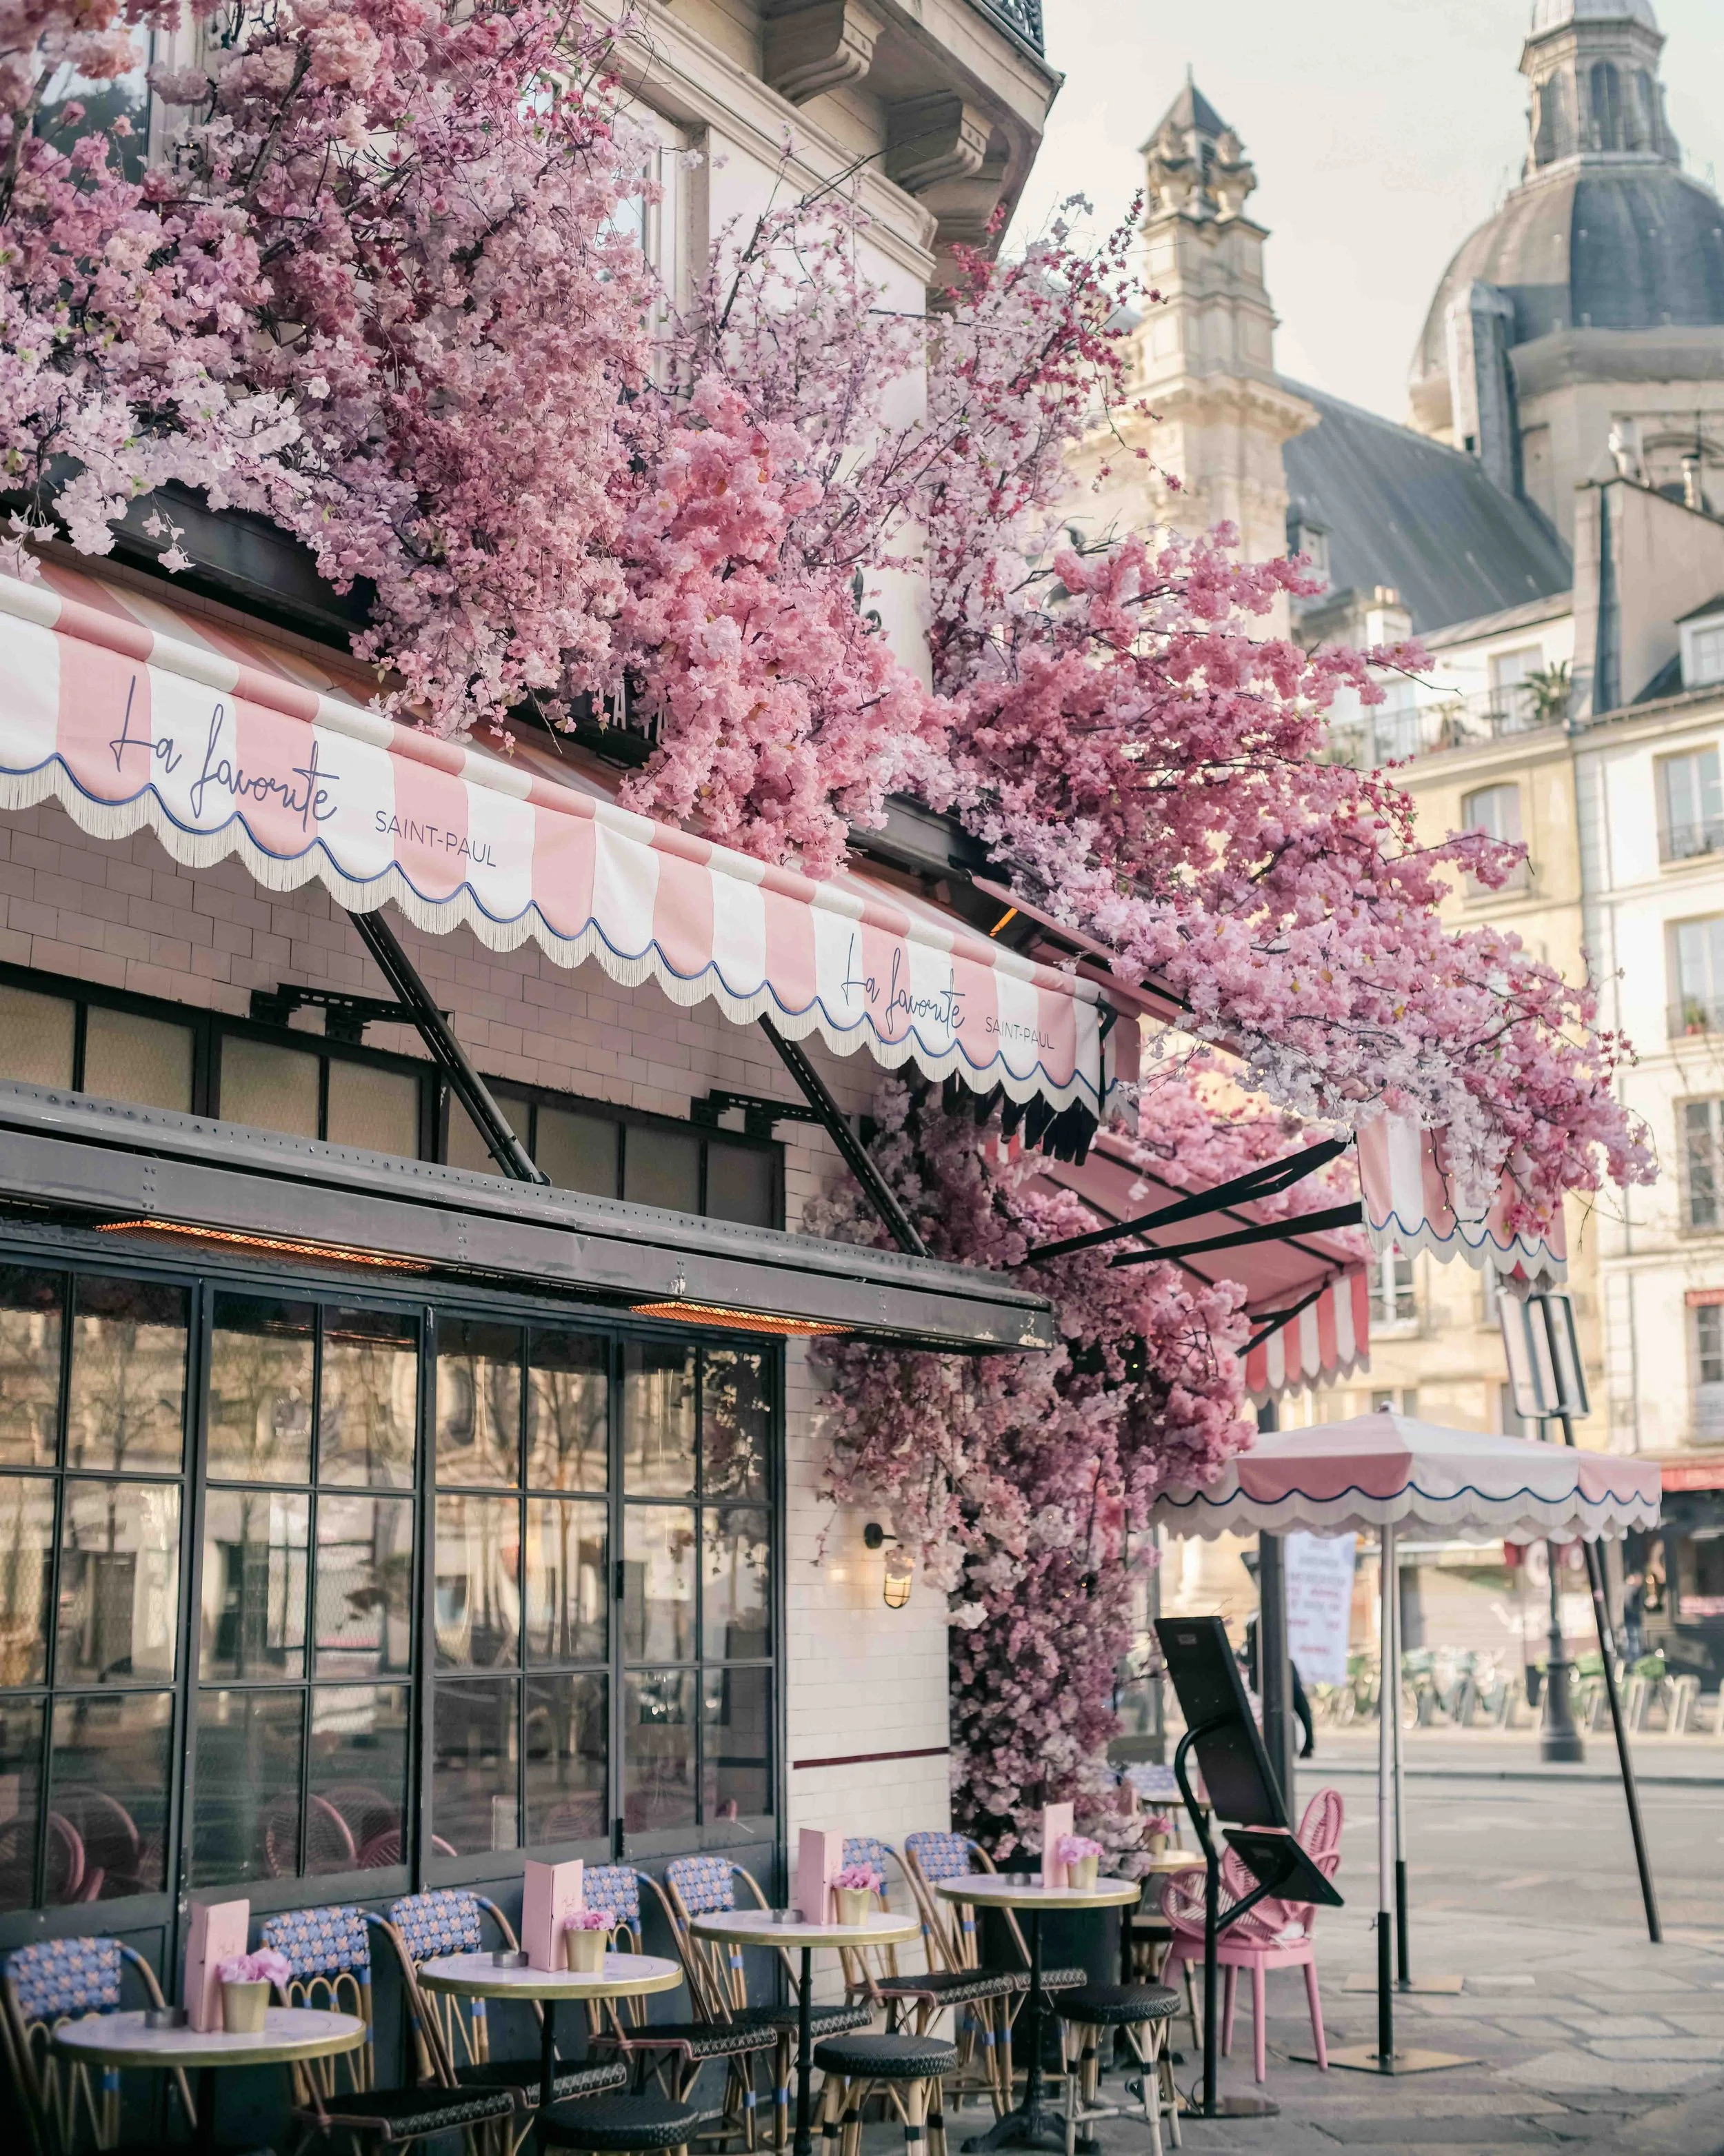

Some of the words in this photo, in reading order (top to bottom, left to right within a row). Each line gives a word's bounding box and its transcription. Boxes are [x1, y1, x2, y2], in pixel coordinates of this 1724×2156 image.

[108, 674, 183, 774] La
[190, 703, 341, 833] favorite
[374, 809, 497, 868] SAINT-PAUL
[841, 932, 881, 1007] La
[885, 947, 966, 1039] favorite
[985, 1016, 1055, 1050] SAINT-PAUL
